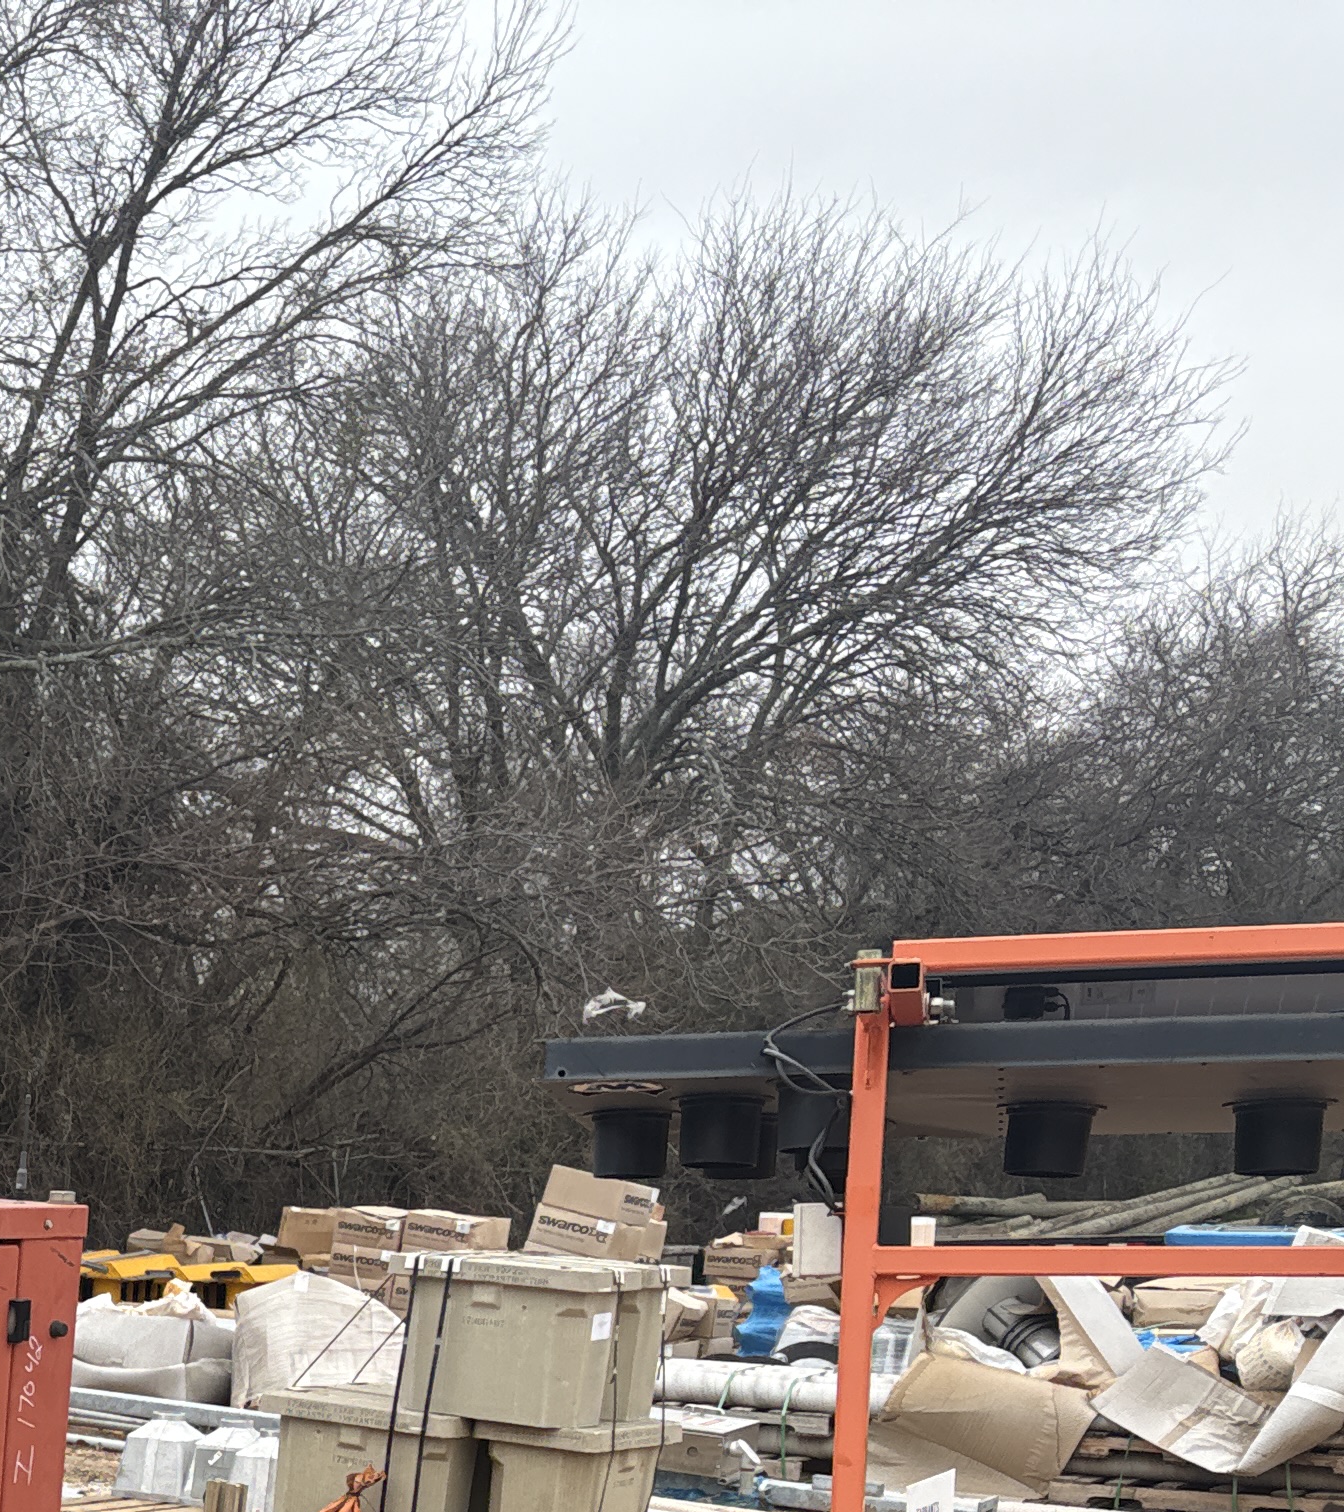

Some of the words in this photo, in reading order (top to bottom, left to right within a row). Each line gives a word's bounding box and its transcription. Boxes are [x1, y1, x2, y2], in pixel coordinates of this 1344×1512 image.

[338, 1221, 378, 1235] swarco
[408, 1222, 450, 1237] swarco
[538, 1215, 590, 1234] swarco
[333, 1252, 374, 1265] swarco
[707, 1255, 745, 1265] swarco
